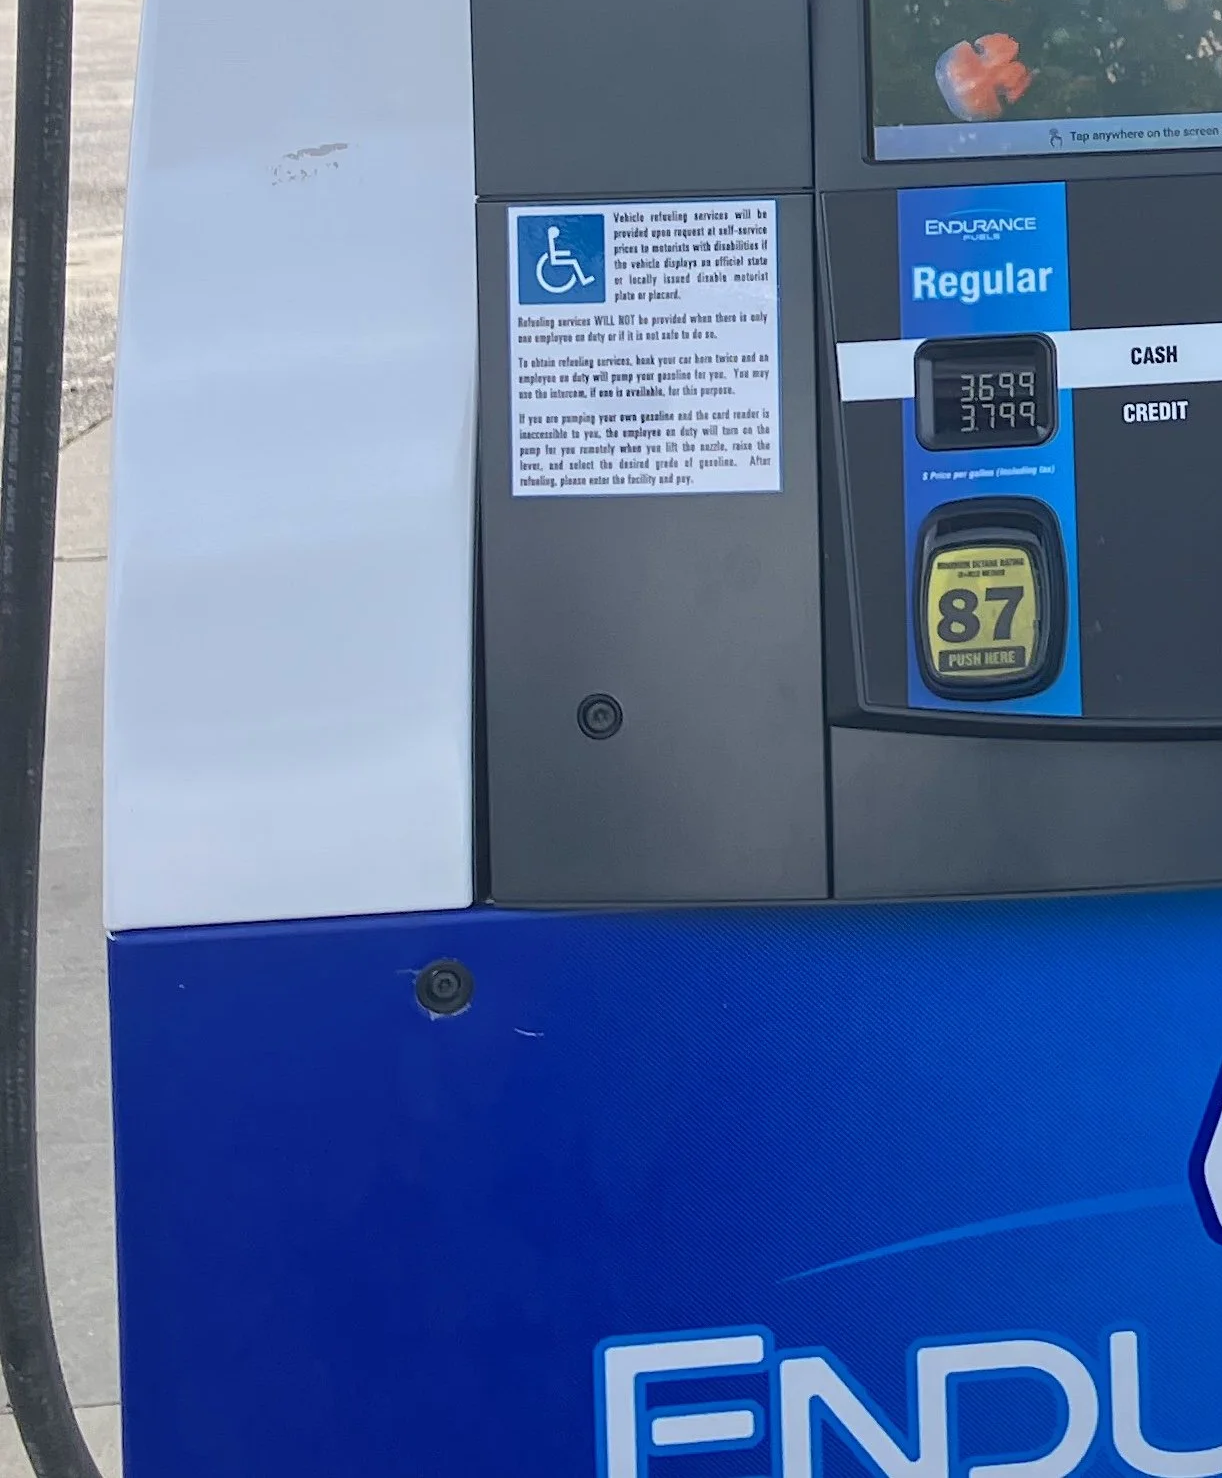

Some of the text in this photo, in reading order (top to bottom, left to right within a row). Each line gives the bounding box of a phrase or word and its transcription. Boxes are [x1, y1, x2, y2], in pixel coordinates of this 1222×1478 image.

[1070, 130, 1089, 144] Tap
[1092, 128, 1144, 142] anywhere
[1147, 128, 1160, 138] on
[1163, 127, 1180, 138] the
[1183, 125, 1219, 136] screen
[613, 208, 767, 223] Vehicle refueling services will be
[613, 224, 767, 240] provided upon request at self-service
[925, 216, 1037, 236] ENDURANCE
[963, 233, 1001, 241] FUELS
[614, 239, 768, 256] prices to motorists with disabilities if
[614, 259, 627, 269] the
[631, 258, 660, 269] vehicle
[664, 257, 697, 269] displays
[715, 256, 744, 266] official
[747, 256, 768, 266] state
[614, 272, 768, 286] or locally issued disable motorist
[912, 262, 1053, 303] Regular
[614, 289, 681, 303] plate or placard.
[1131, 345, 1178, 365] CASH
[1123, 400, 1189, 423] CREDIT
[936, 585, 1025, 643] 87
[949, 650, 1016, 667] PUSH HERE
